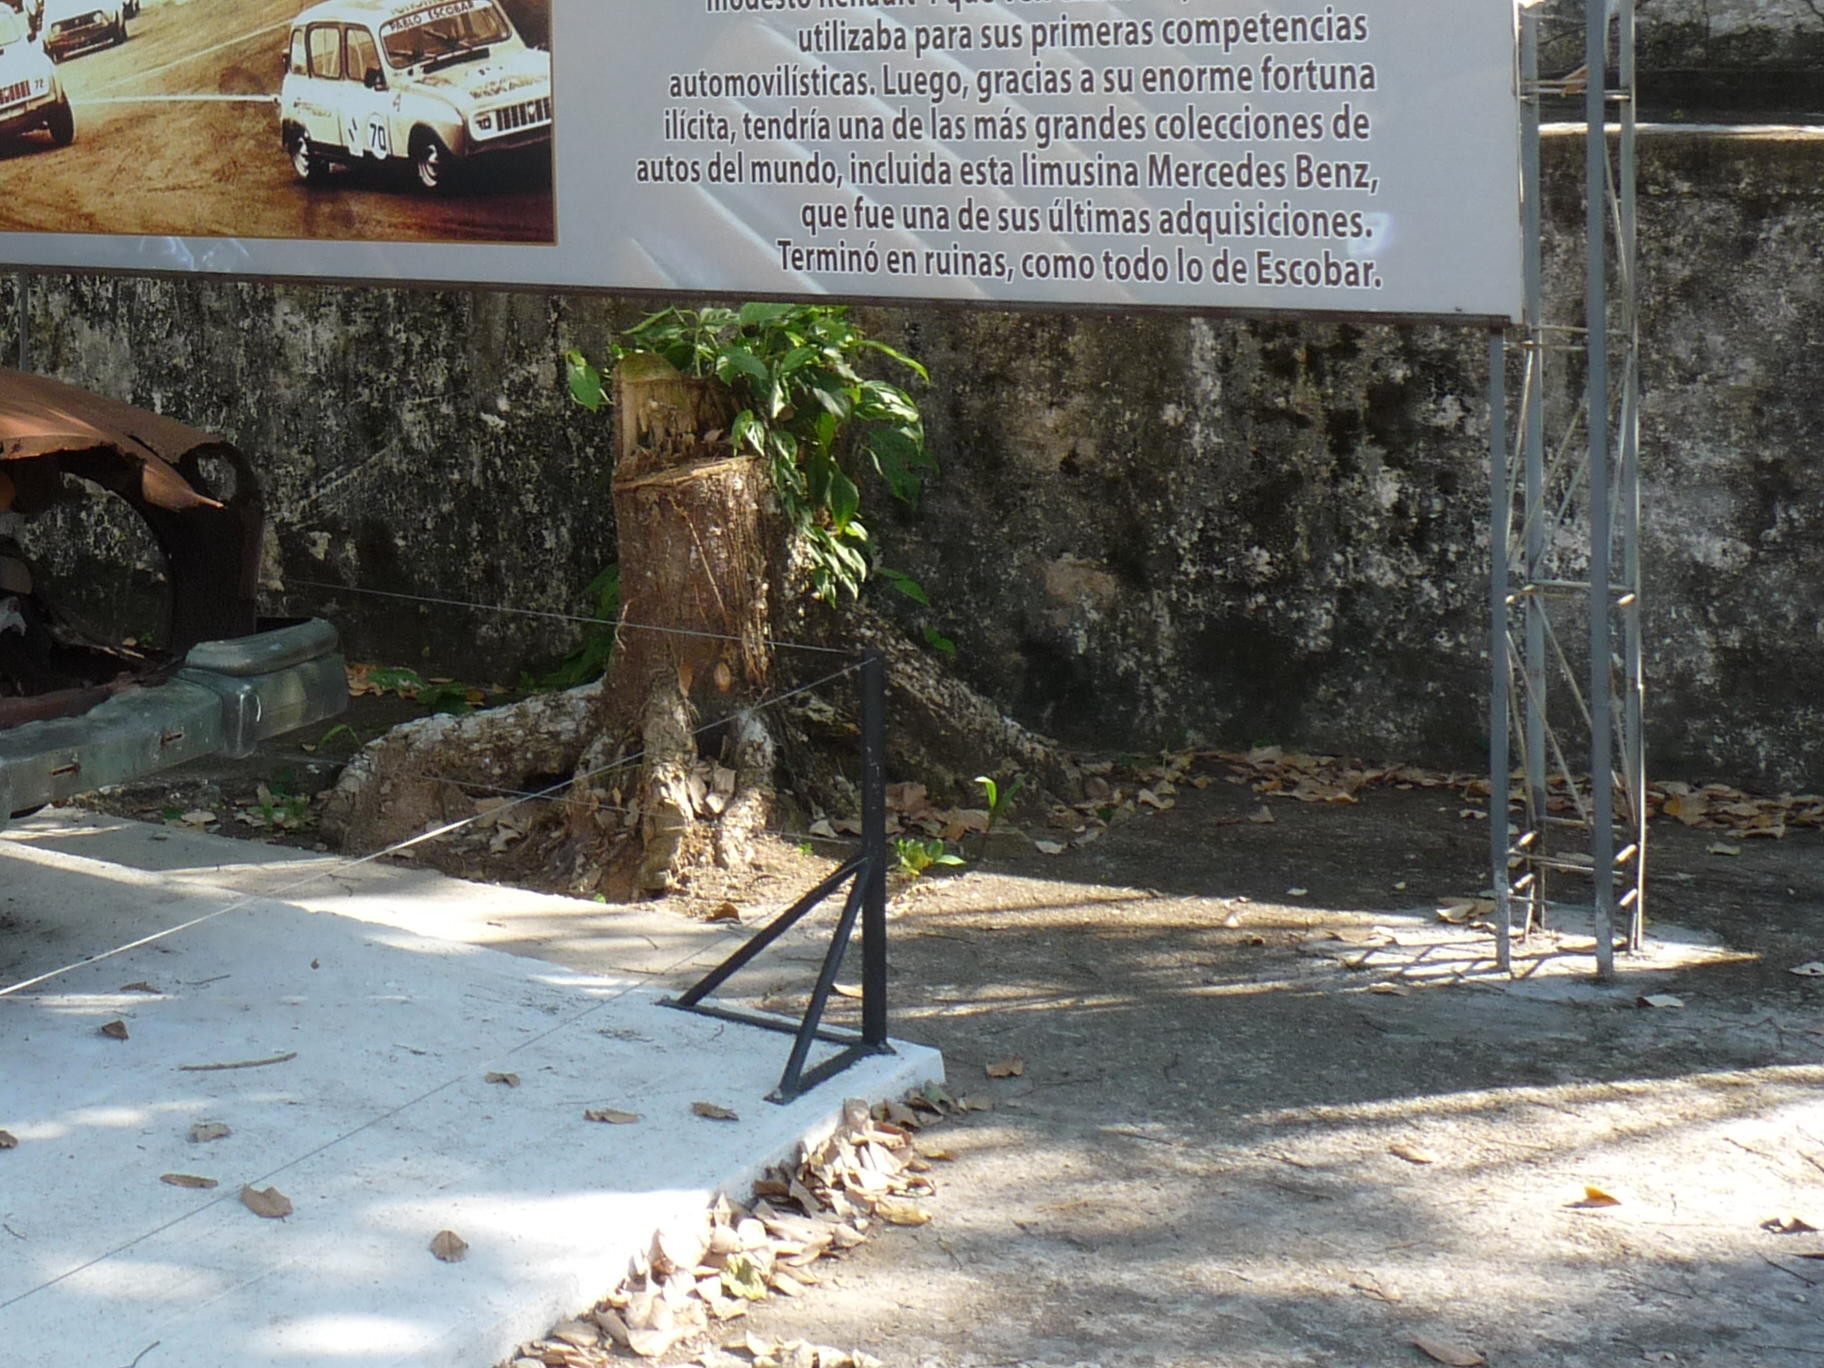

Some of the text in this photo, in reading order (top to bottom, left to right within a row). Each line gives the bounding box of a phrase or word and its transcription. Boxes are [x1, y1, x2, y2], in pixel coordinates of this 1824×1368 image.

[390, 14, 423, 31] PABLO
[427, 0, 474, 20] ESCOBAR
[798, 7, 1367, 57] utilizaba para sus primeras competencias
[670, 56, 1376, 103] automovilísticas. Luego, gracias a su enorme fortuna
[369, 122, 387, 151] 70
[665, 104, 1370, 147] ilícita, tendría una de las más grandes colecciones de
[637, 152, 1378, 194] autos del mundo, incluida esta limusina Mercedes Benz,
[802, 197, 1372, 243] que fue una de sus últimas adquisiciones.
[777, 240, 1382, 288] Terminó en ruinas, como todo lo de Escobar.
